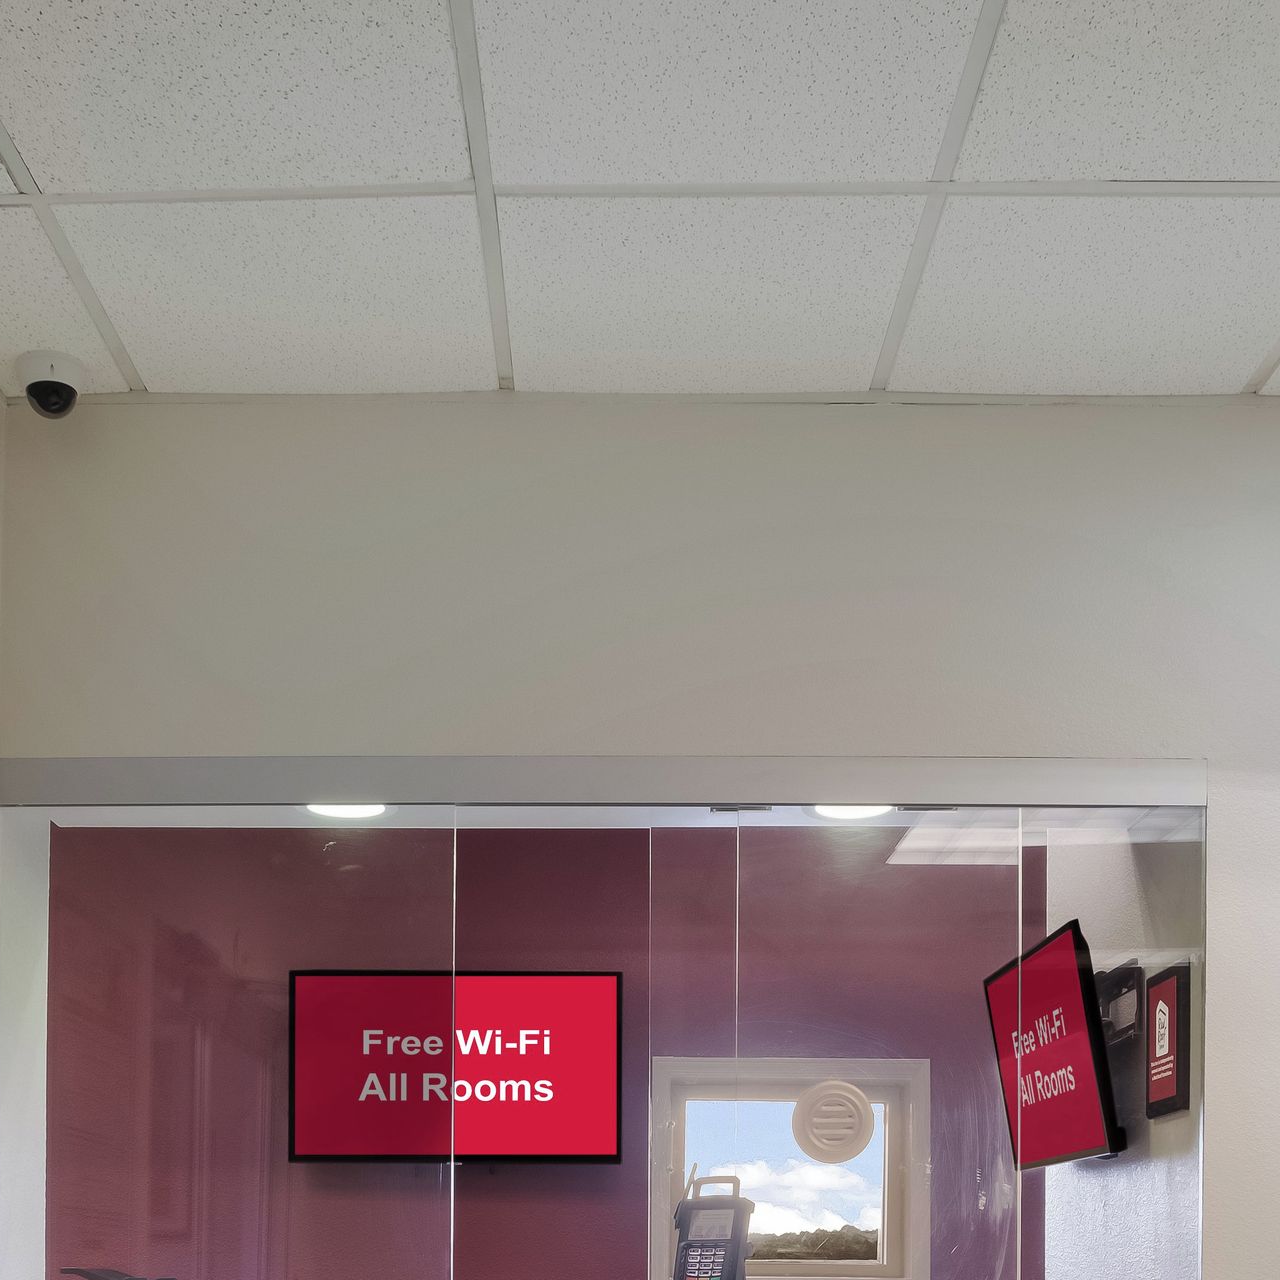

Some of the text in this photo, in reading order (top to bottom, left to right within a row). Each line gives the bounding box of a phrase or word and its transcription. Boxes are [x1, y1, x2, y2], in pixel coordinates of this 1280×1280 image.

[363, 1029, 551, 1055] Free Wi-Fi
[1011, 1007, 1067, 1059] Free Wi-Fi
[358, 1072, 554, 1102] All Rooms
[1020, 1065, 1076, 1108] All Rooms
